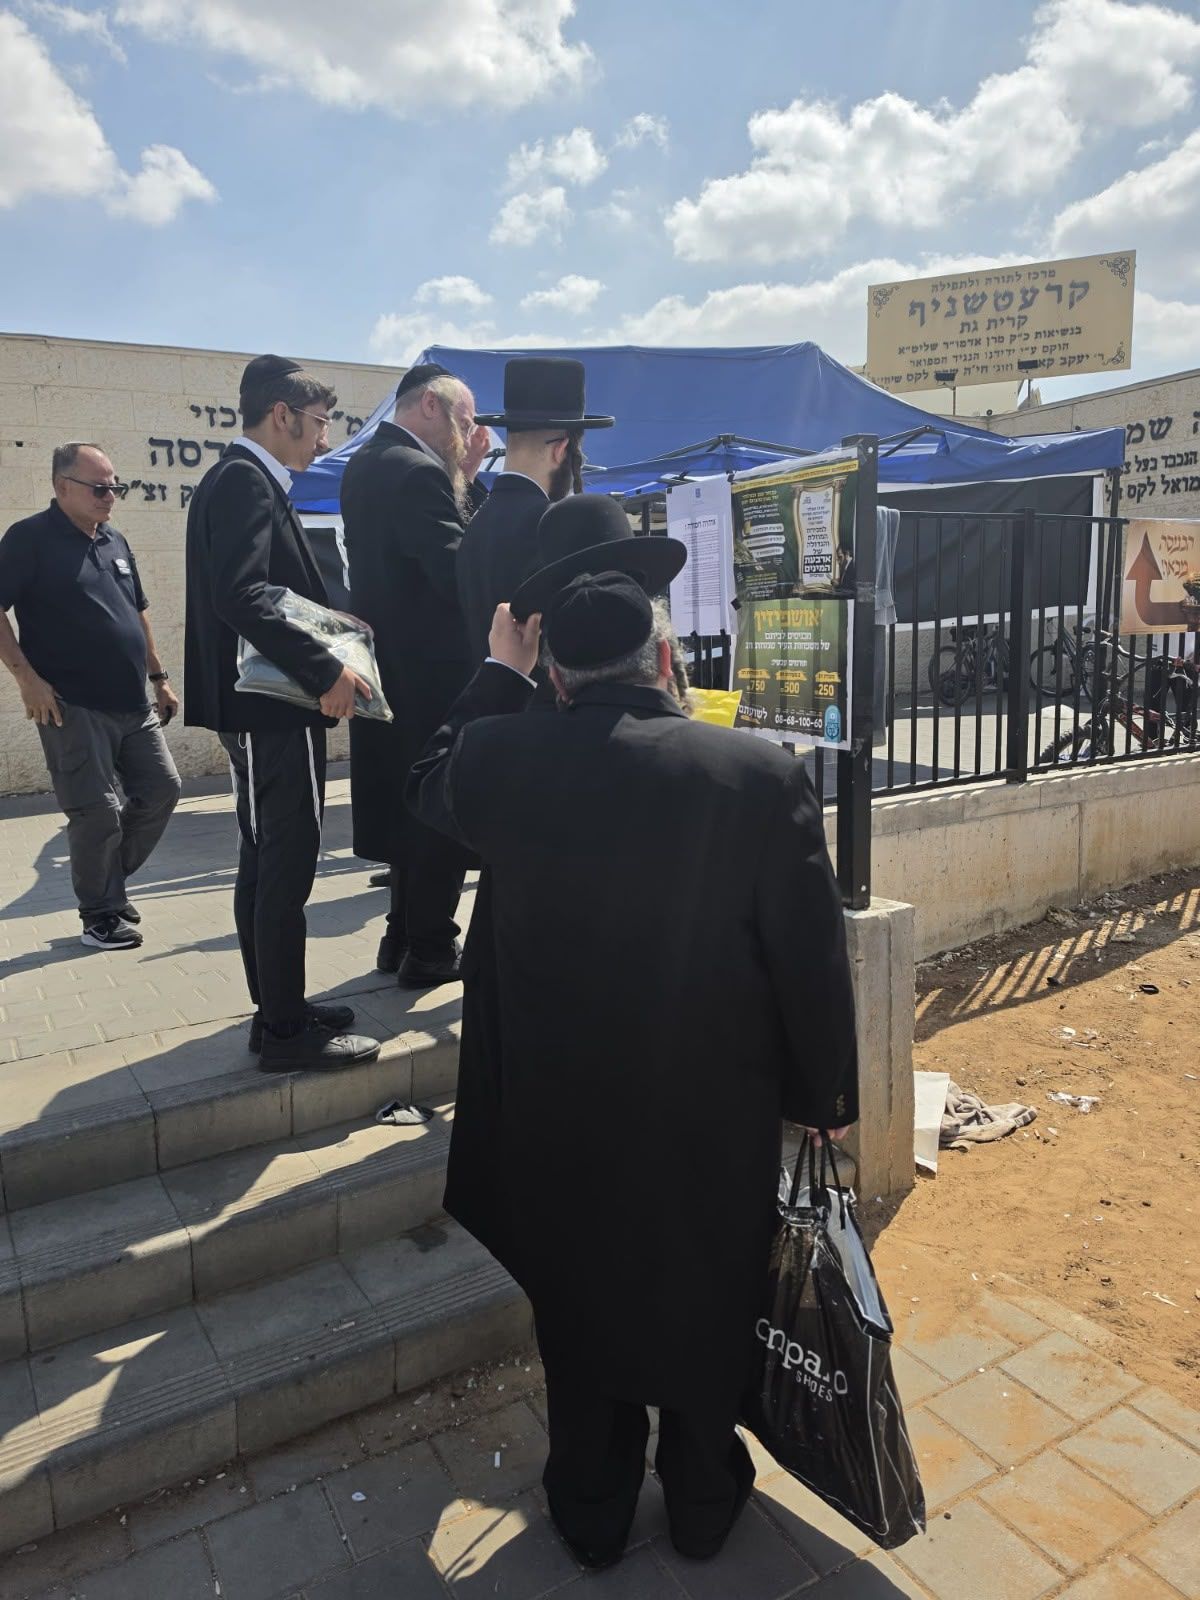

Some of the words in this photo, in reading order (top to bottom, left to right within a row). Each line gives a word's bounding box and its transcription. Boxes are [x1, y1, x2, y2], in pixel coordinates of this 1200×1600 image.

[985, 271, 1022, 286] לתורה
[1027, 269, 1056, 280] מרכז
[931, 277, 979, 293] ולתפילה
[908, 280, 1090, 327] קרעטשניף
[959, 320, 978, 334] גת
[986, 315, 1028, 331] קרית
[1034, 326, 1082, 340] בנשיאות
[1042, 342, 1069, 354] הוקם
[1059, 355, 1090, 367] יעקב
[1127, 475, 1156, 504] לקס
[1160, 474, 1200, 495] מואל
[804, 555, 832, 565] ארבעת
[804, 564, 831, 573] המינים
[820, 639, 831, 651] של
[795, 1370, 834, 1402] SHOES
